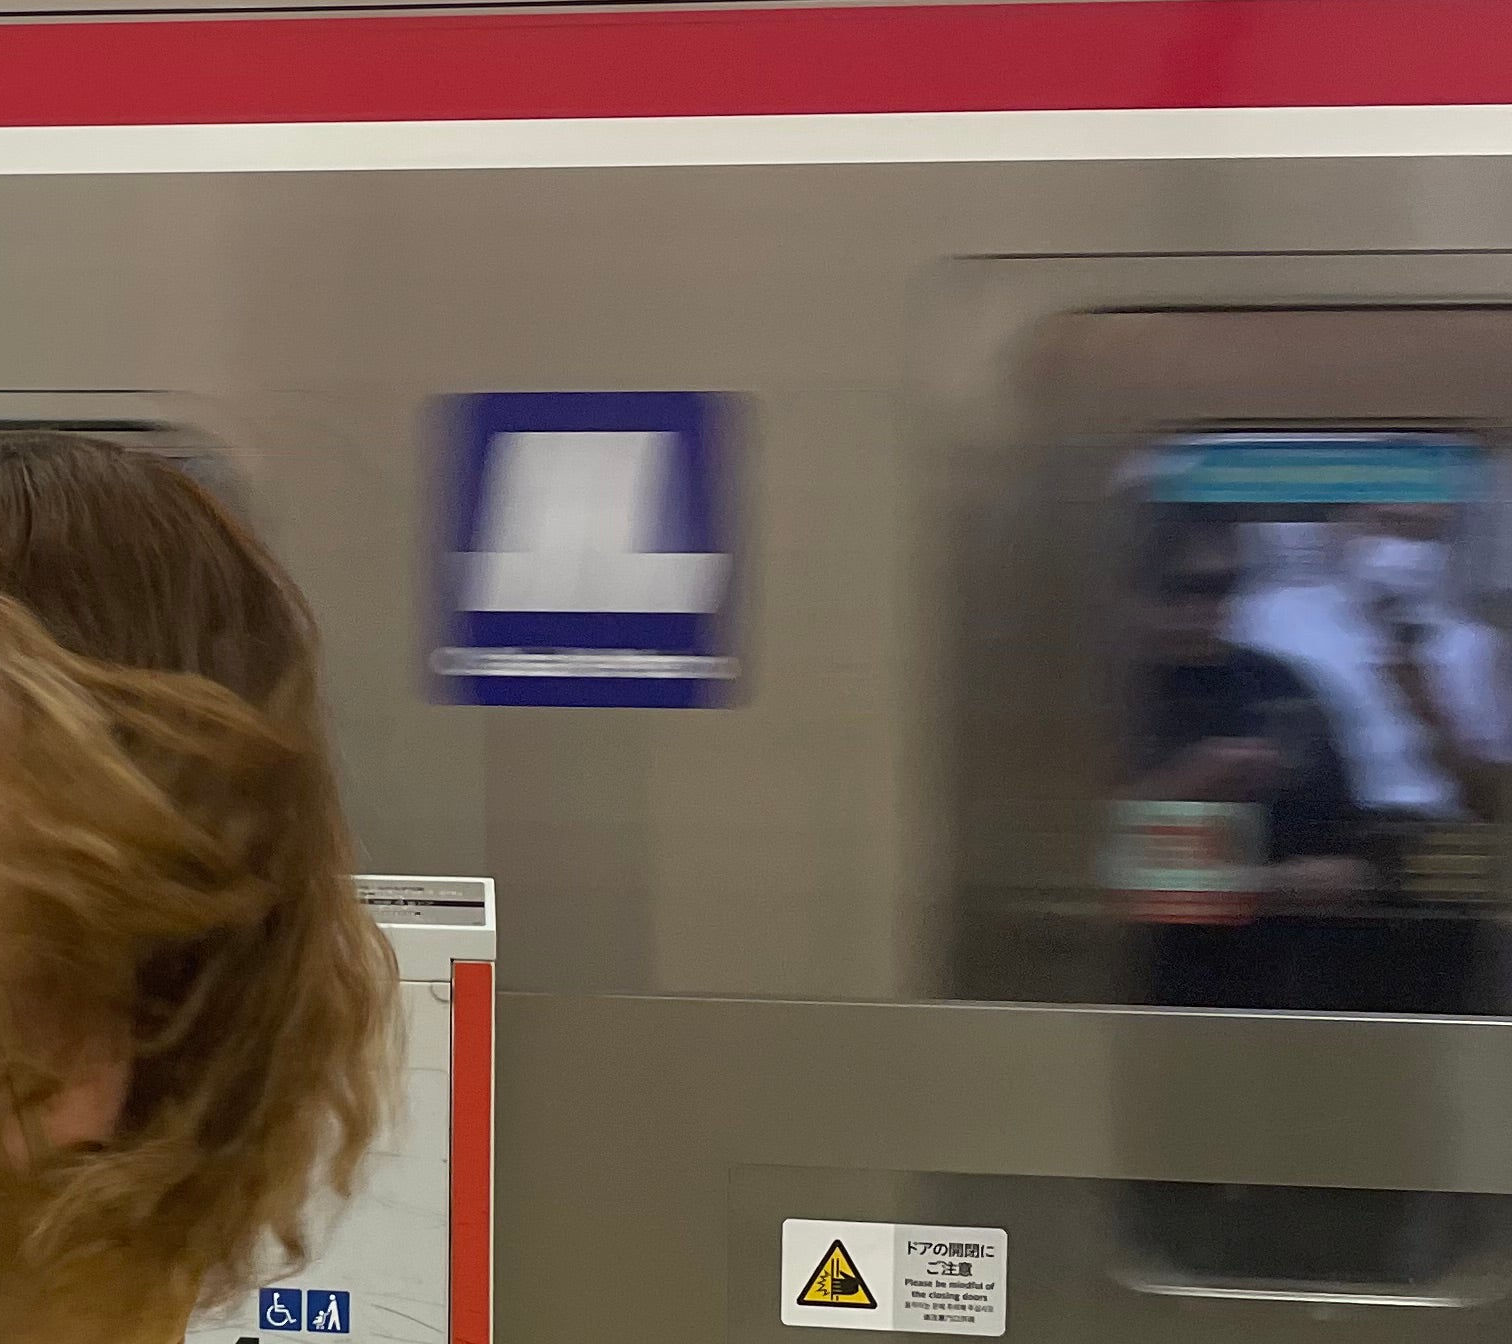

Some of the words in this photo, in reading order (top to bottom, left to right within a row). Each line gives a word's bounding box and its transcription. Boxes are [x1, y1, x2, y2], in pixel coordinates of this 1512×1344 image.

[908, 1240, 995, 1258] ドアの開閉に
[926, 1260, 973, 1277] ご注意
[904, 1278, 933, 1287] Please
[936, 1280, 947, 1288] be
[986, 1282, 995, 1290] of
[928, 1292, 960, 1302] closing
[962, 1292, 988, 1302] doors
